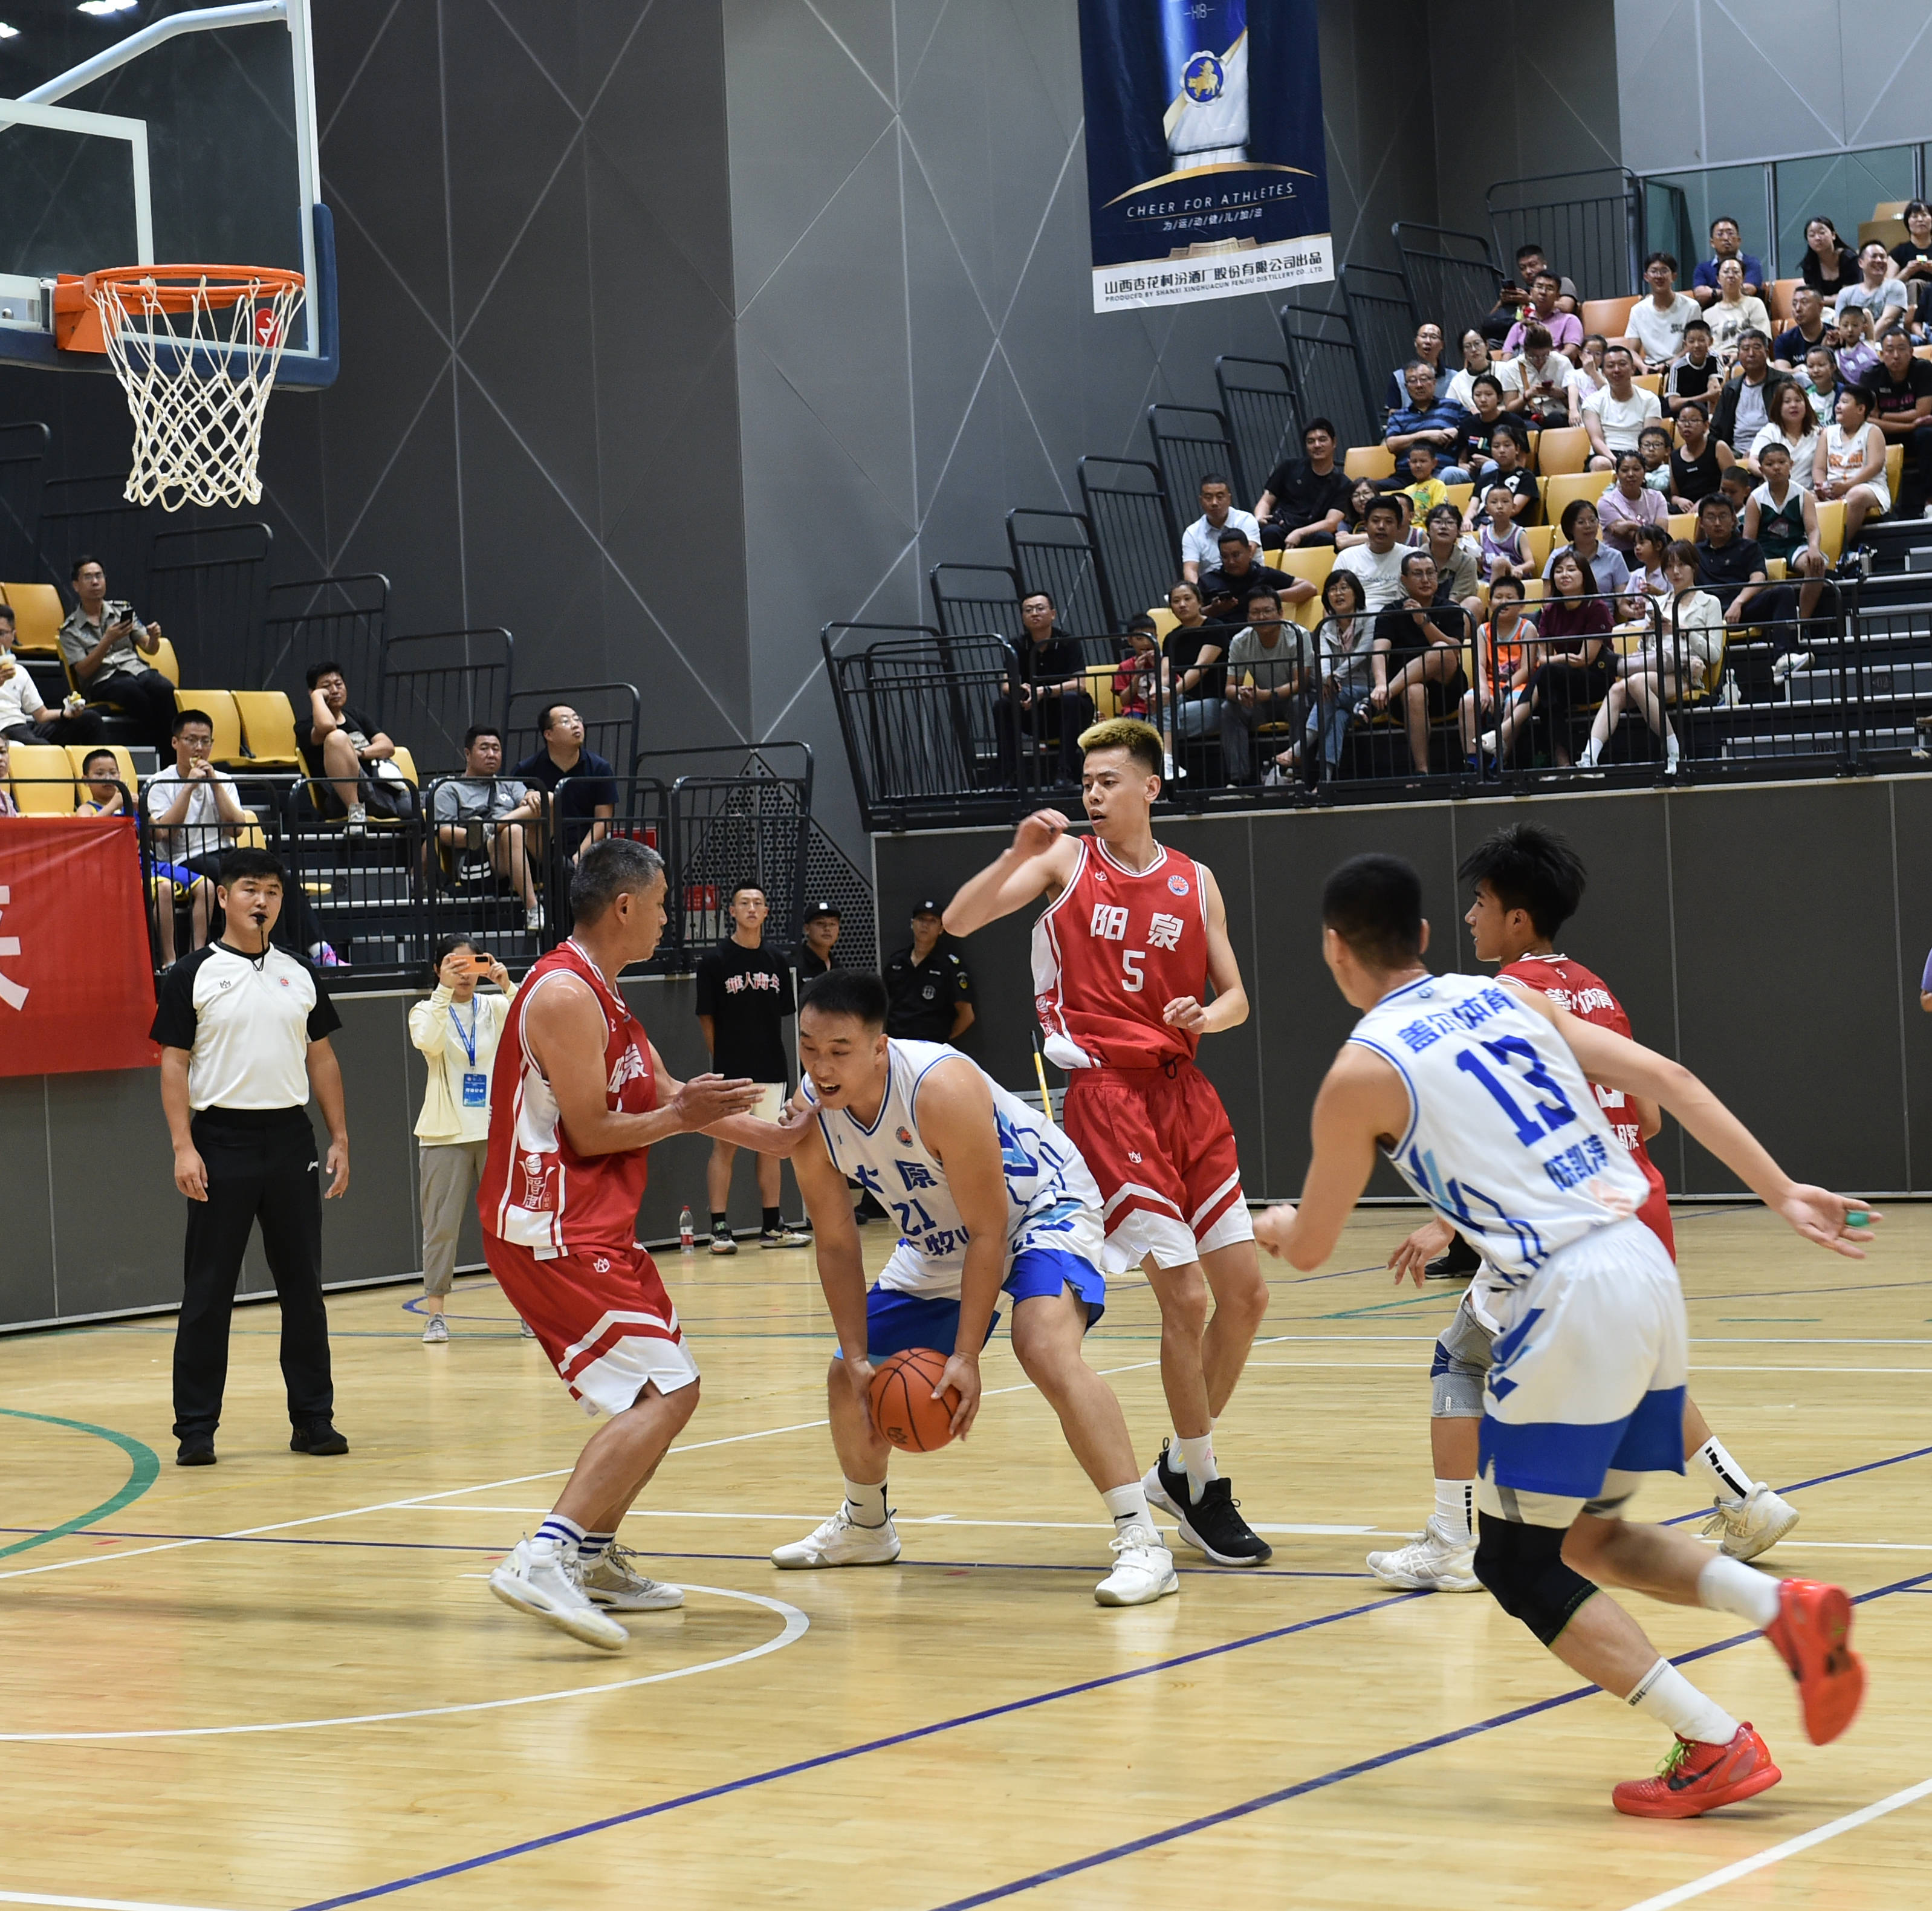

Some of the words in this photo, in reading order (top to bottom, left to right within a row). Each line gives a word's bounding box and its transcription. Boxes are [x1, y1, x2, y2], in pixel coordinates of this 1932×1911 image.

[1126, 202, 1176, 218] CHEER
[1184, 196, 1213, 210] FOR
[1220, 182, 1294, 206] ATHLETES
[1104, 251, 1322, 294] 山西杏花村汾酒厂股份有限公司出品
[1105, 293, 1143, 302] PRODUCED
[1156, 287, 1181, 296] SHANXI
[1183, 281, 1230, 293] XINGHUACUN
[1231, 277, 1255, 287] FENJIU
[1257, 271, 1295, 283] DISTILLERY
[1090, 903, 1184, 952] 阳泉
[1121, 949, 1146, 992] 5
[1456, 1034, 1577, 1148] 13
[889, 1198, 937, 1237] 21
